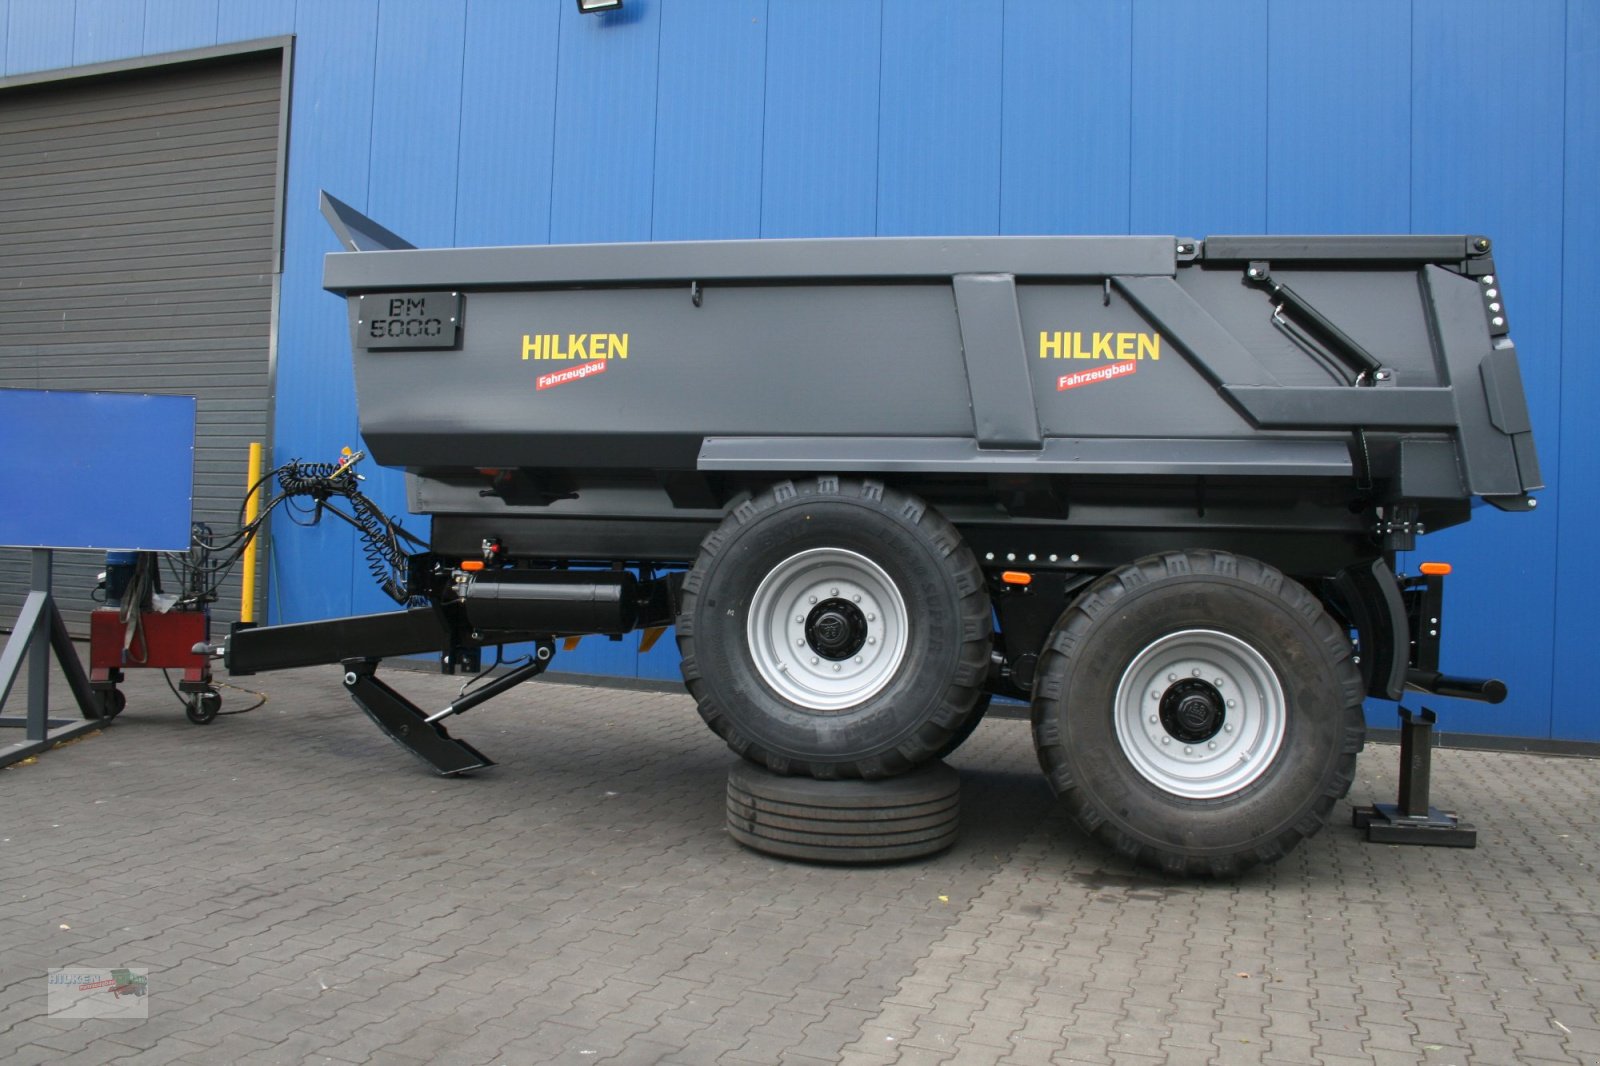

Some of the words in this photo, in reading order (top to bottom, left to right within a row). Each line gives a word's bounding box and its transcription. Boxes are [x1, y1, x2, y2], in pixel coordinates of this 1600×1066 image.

[388, 298, 425, 317] BM
[370, 318, 442, 338] 5000
[522, 333, 629, 360] HILKEN
[1039, 331, 1161, 361] HILKEN
[538, 362, 605, 388] Fahrzeugbau
[1058, 362, 1134, 388] Fahrzeugbau
